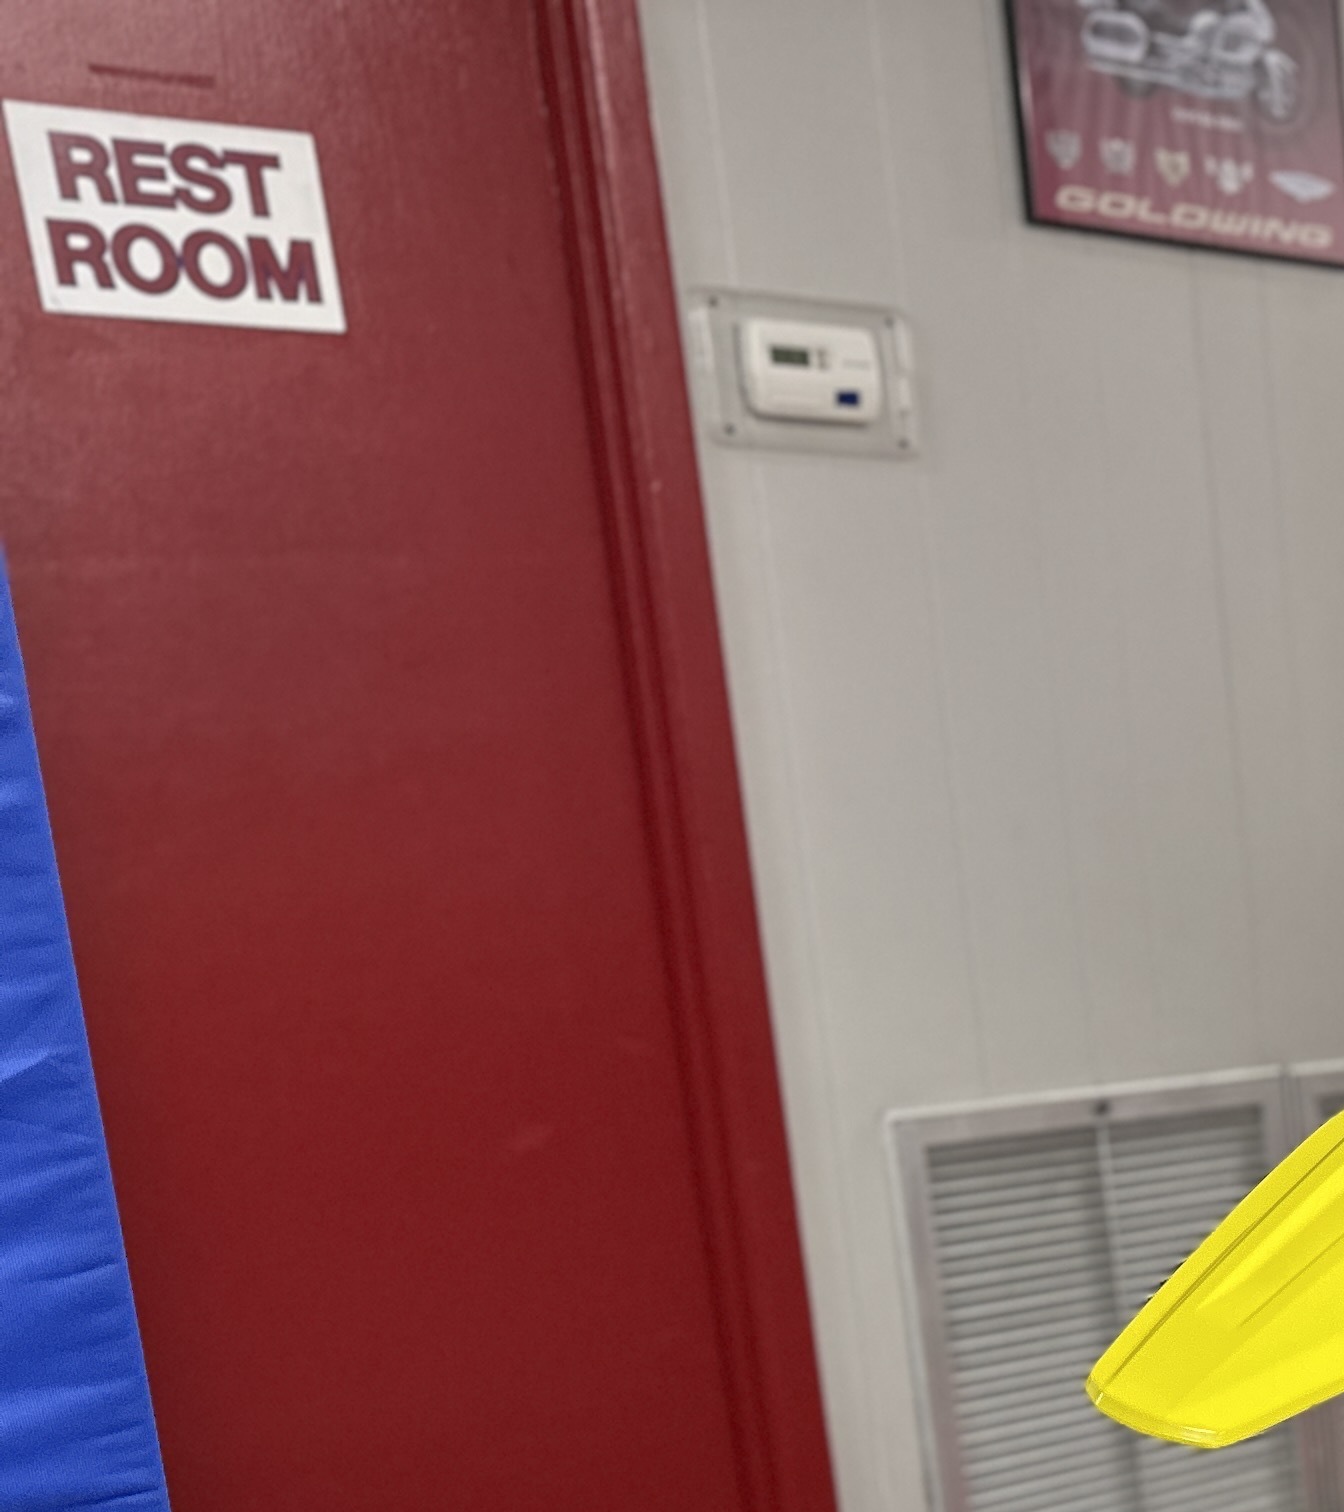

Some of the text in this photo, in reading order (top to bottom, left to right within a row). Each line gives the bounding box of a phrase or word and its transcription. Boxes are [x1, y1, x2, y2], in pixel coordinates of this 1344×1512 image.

[47, 130, 282, 218] REST
[1055, 185, 1334, 247] GOLDWING
[45, 217, 324, 305] ROOM
